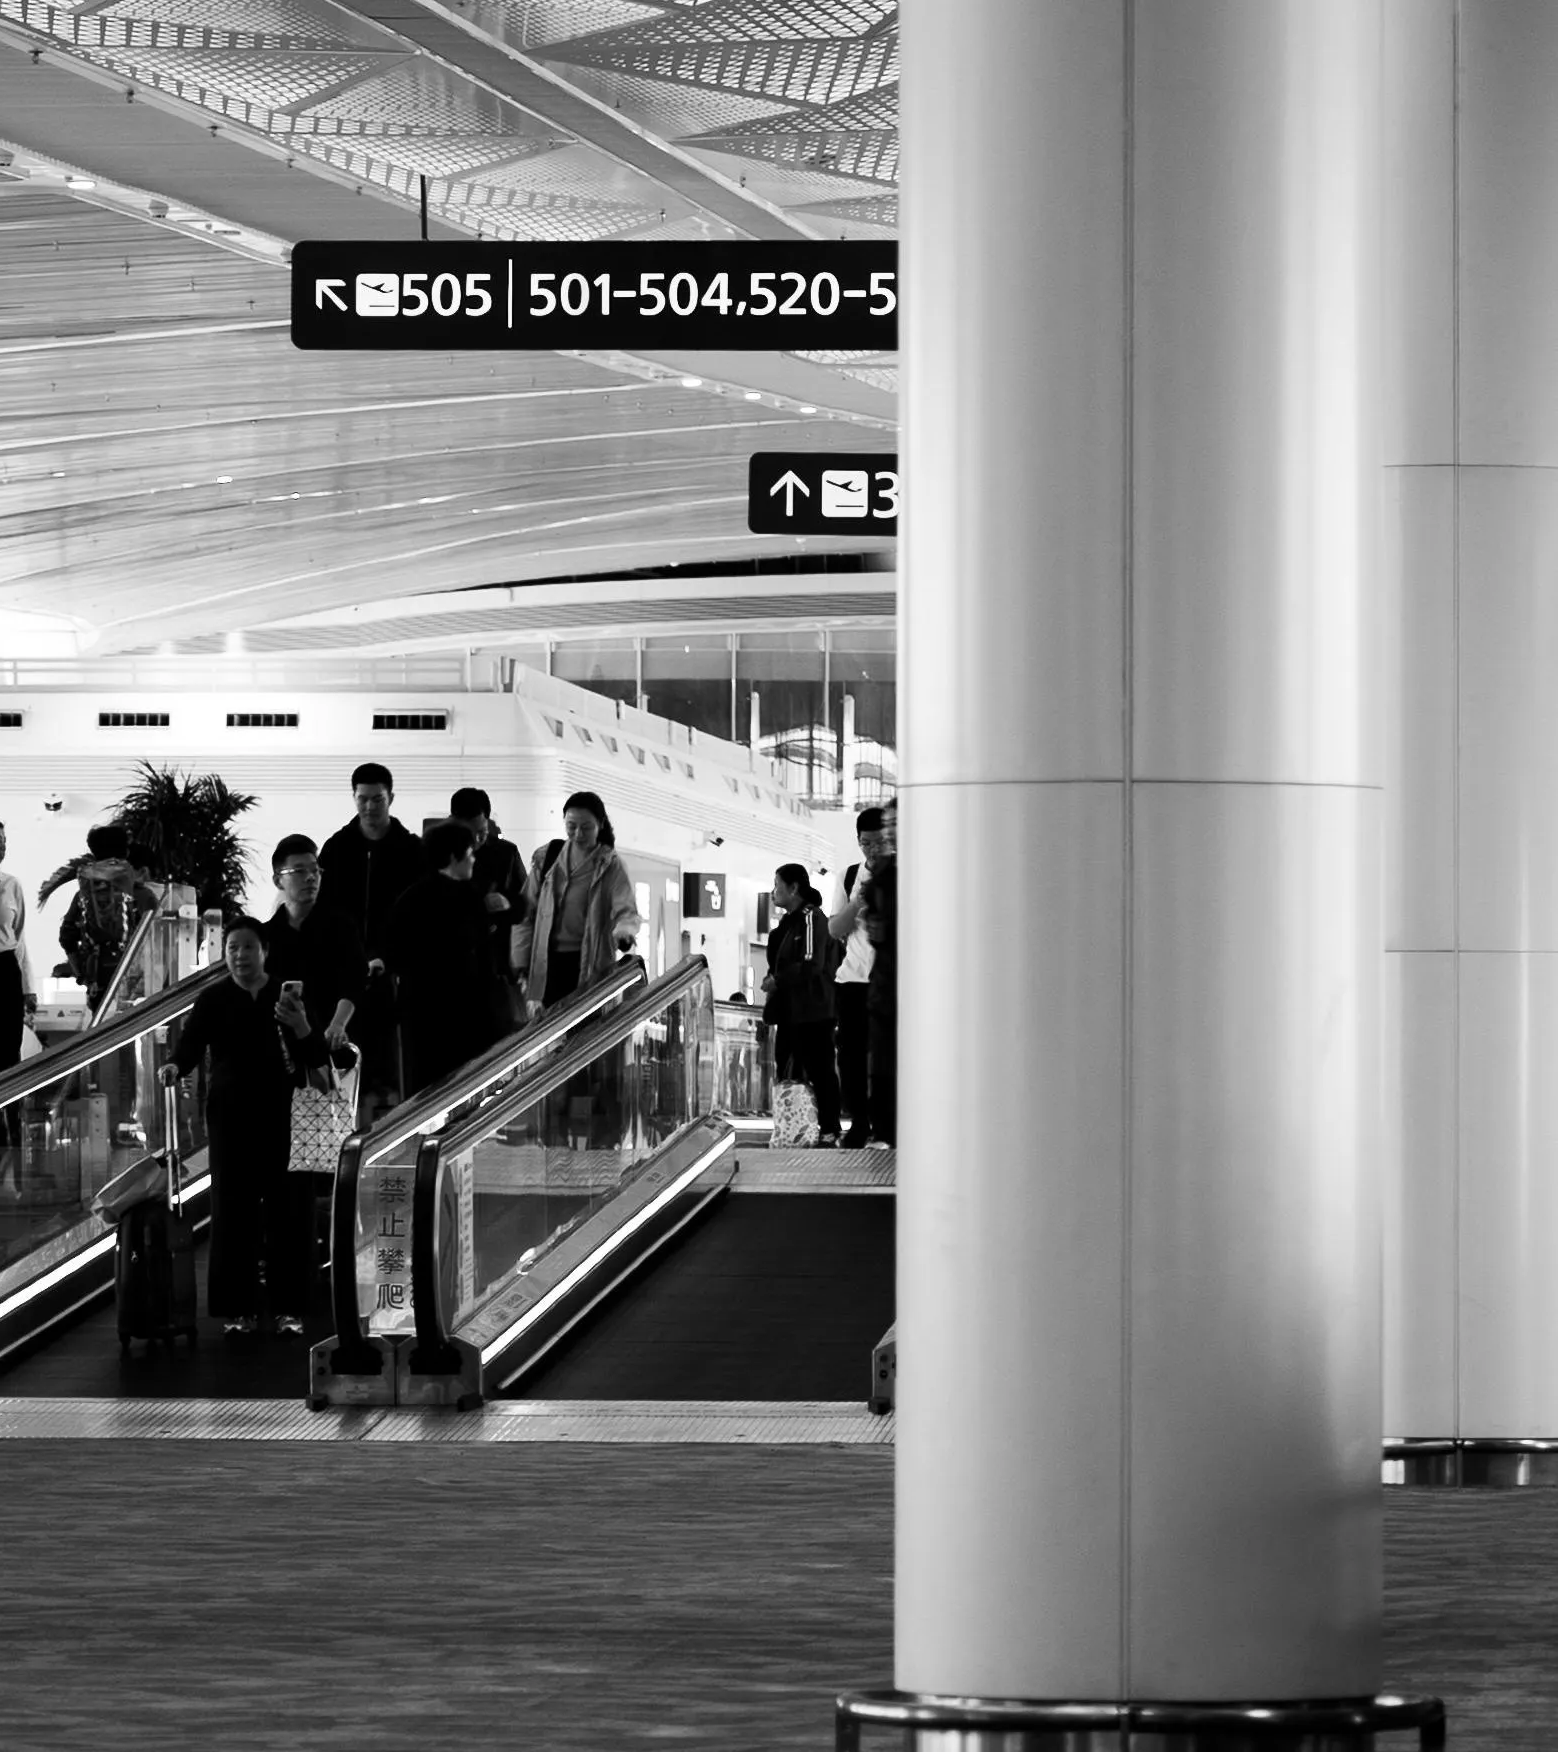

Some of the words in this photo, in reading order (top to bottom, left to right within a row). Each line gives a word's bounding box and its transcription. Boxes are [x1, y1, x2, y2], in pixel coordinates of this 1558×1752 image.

[402, 272, 492, 316] 505
[873, 471, 898, 518] 3
[377, 1176, 407, 1311] 禁止攀爬
